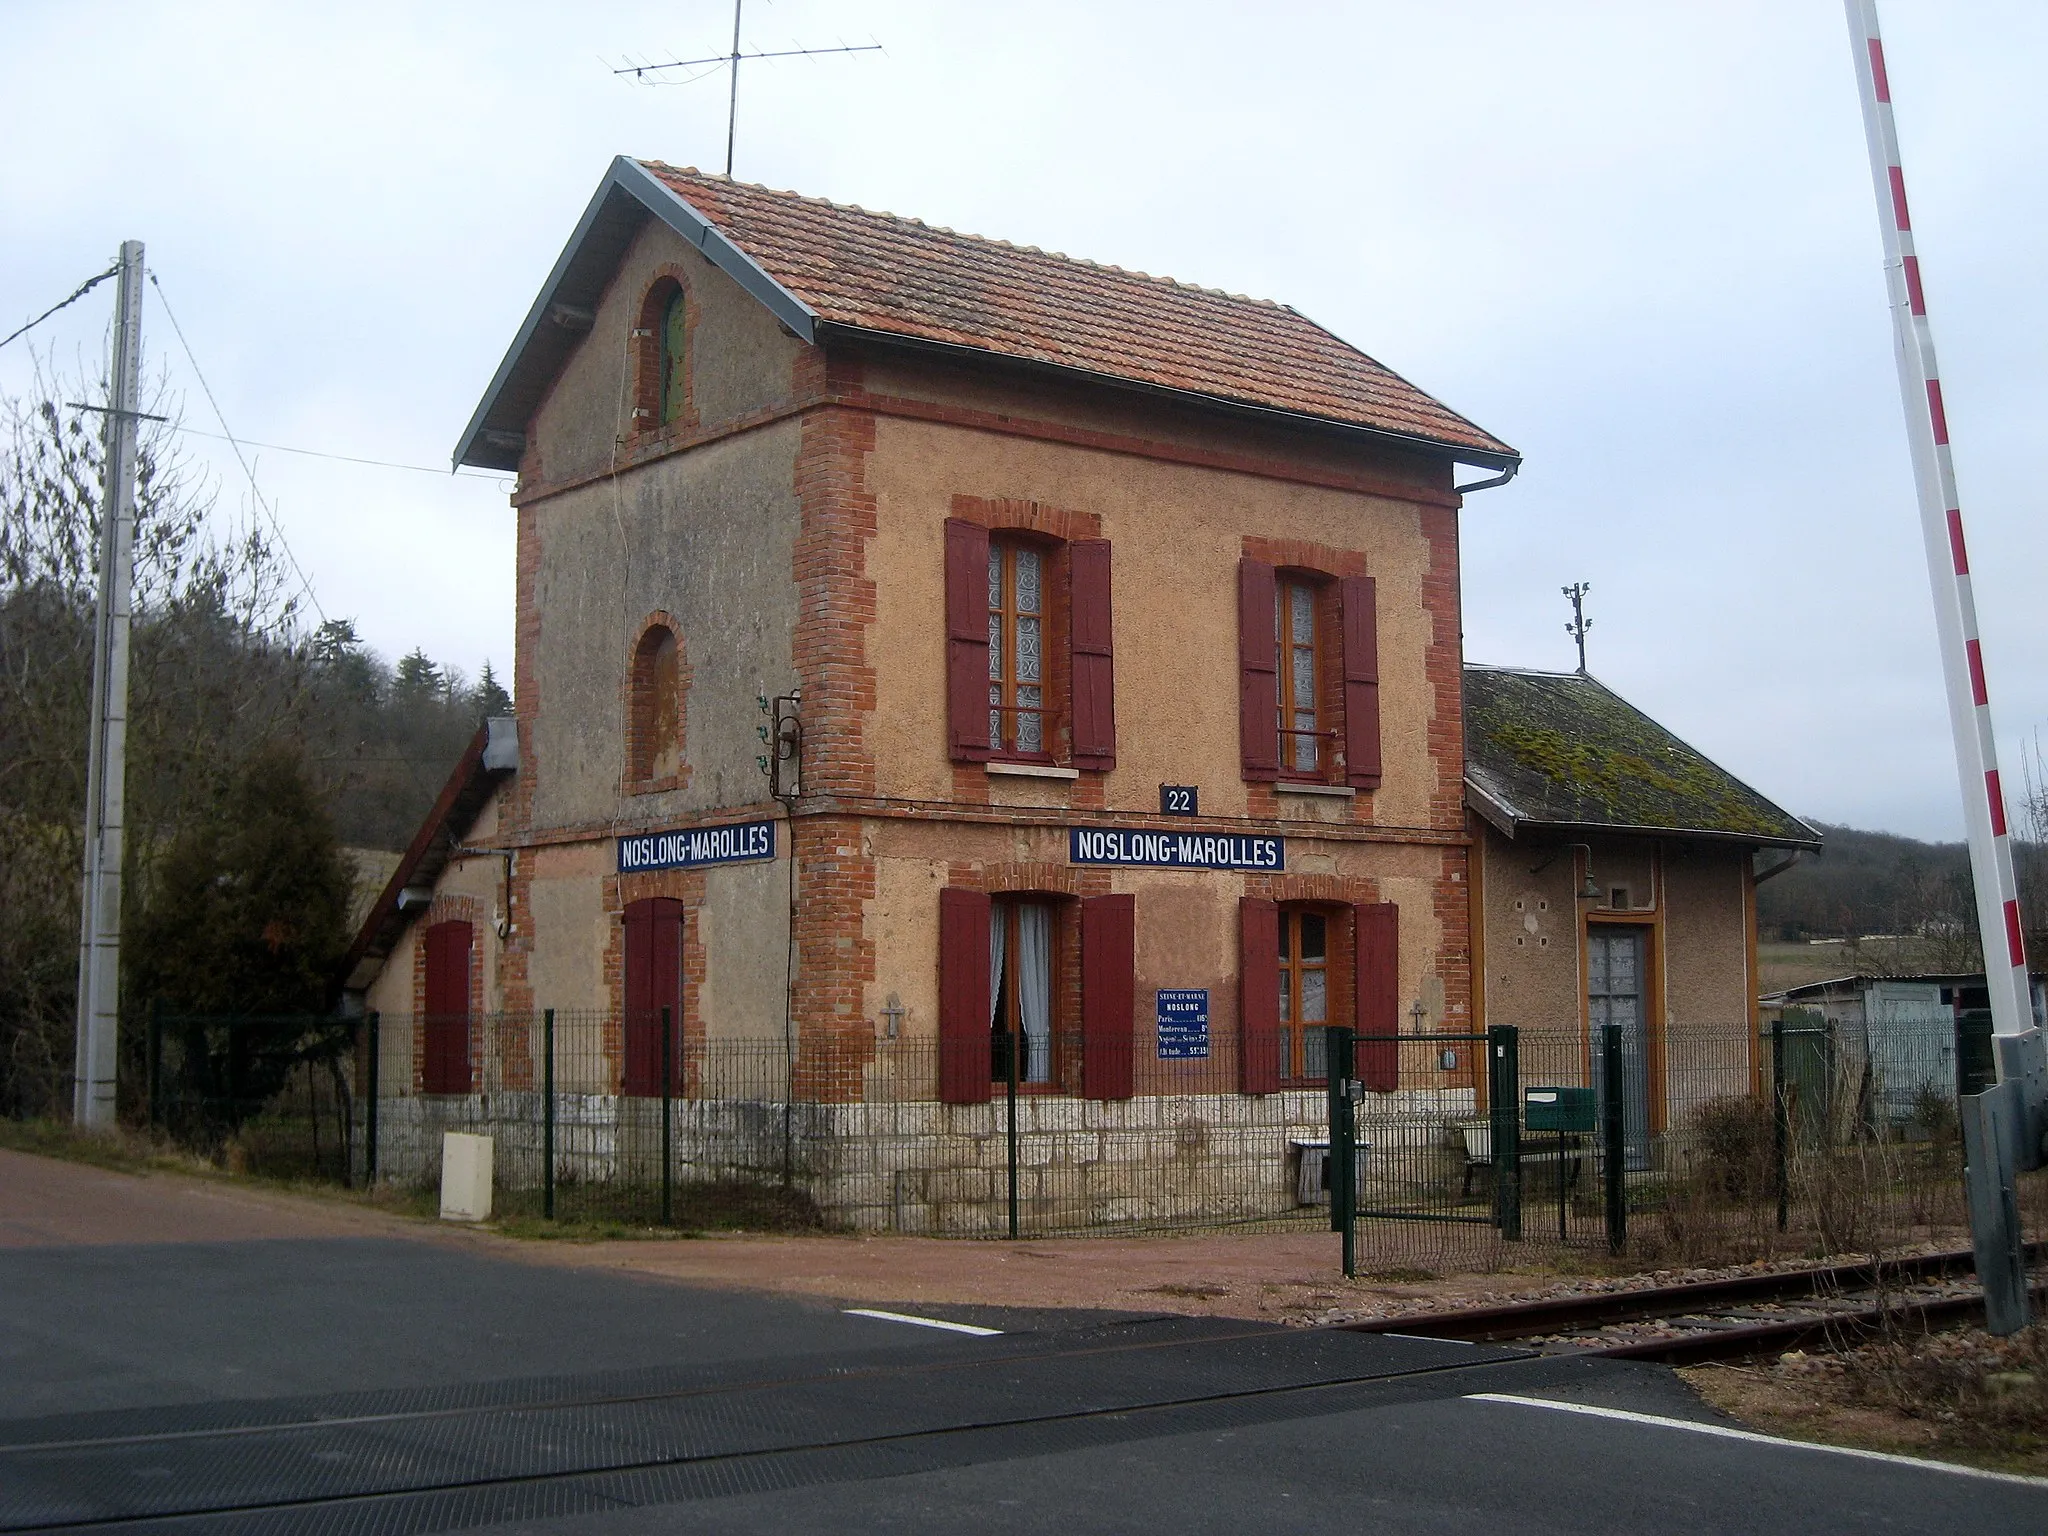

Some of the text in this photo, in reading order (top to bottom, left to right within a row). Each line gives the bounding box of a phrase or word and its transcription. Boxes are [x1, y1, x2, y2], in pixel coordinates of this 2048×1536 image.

[1168, 790, 1190, 811] 22
[622, 825, 768, 867] NOSLONG-MAROLLES
[1078, 831, 1277, 866] NOSLONG-MAROLLES
[1166, 1003, 1199, 1011] NOSLONG
